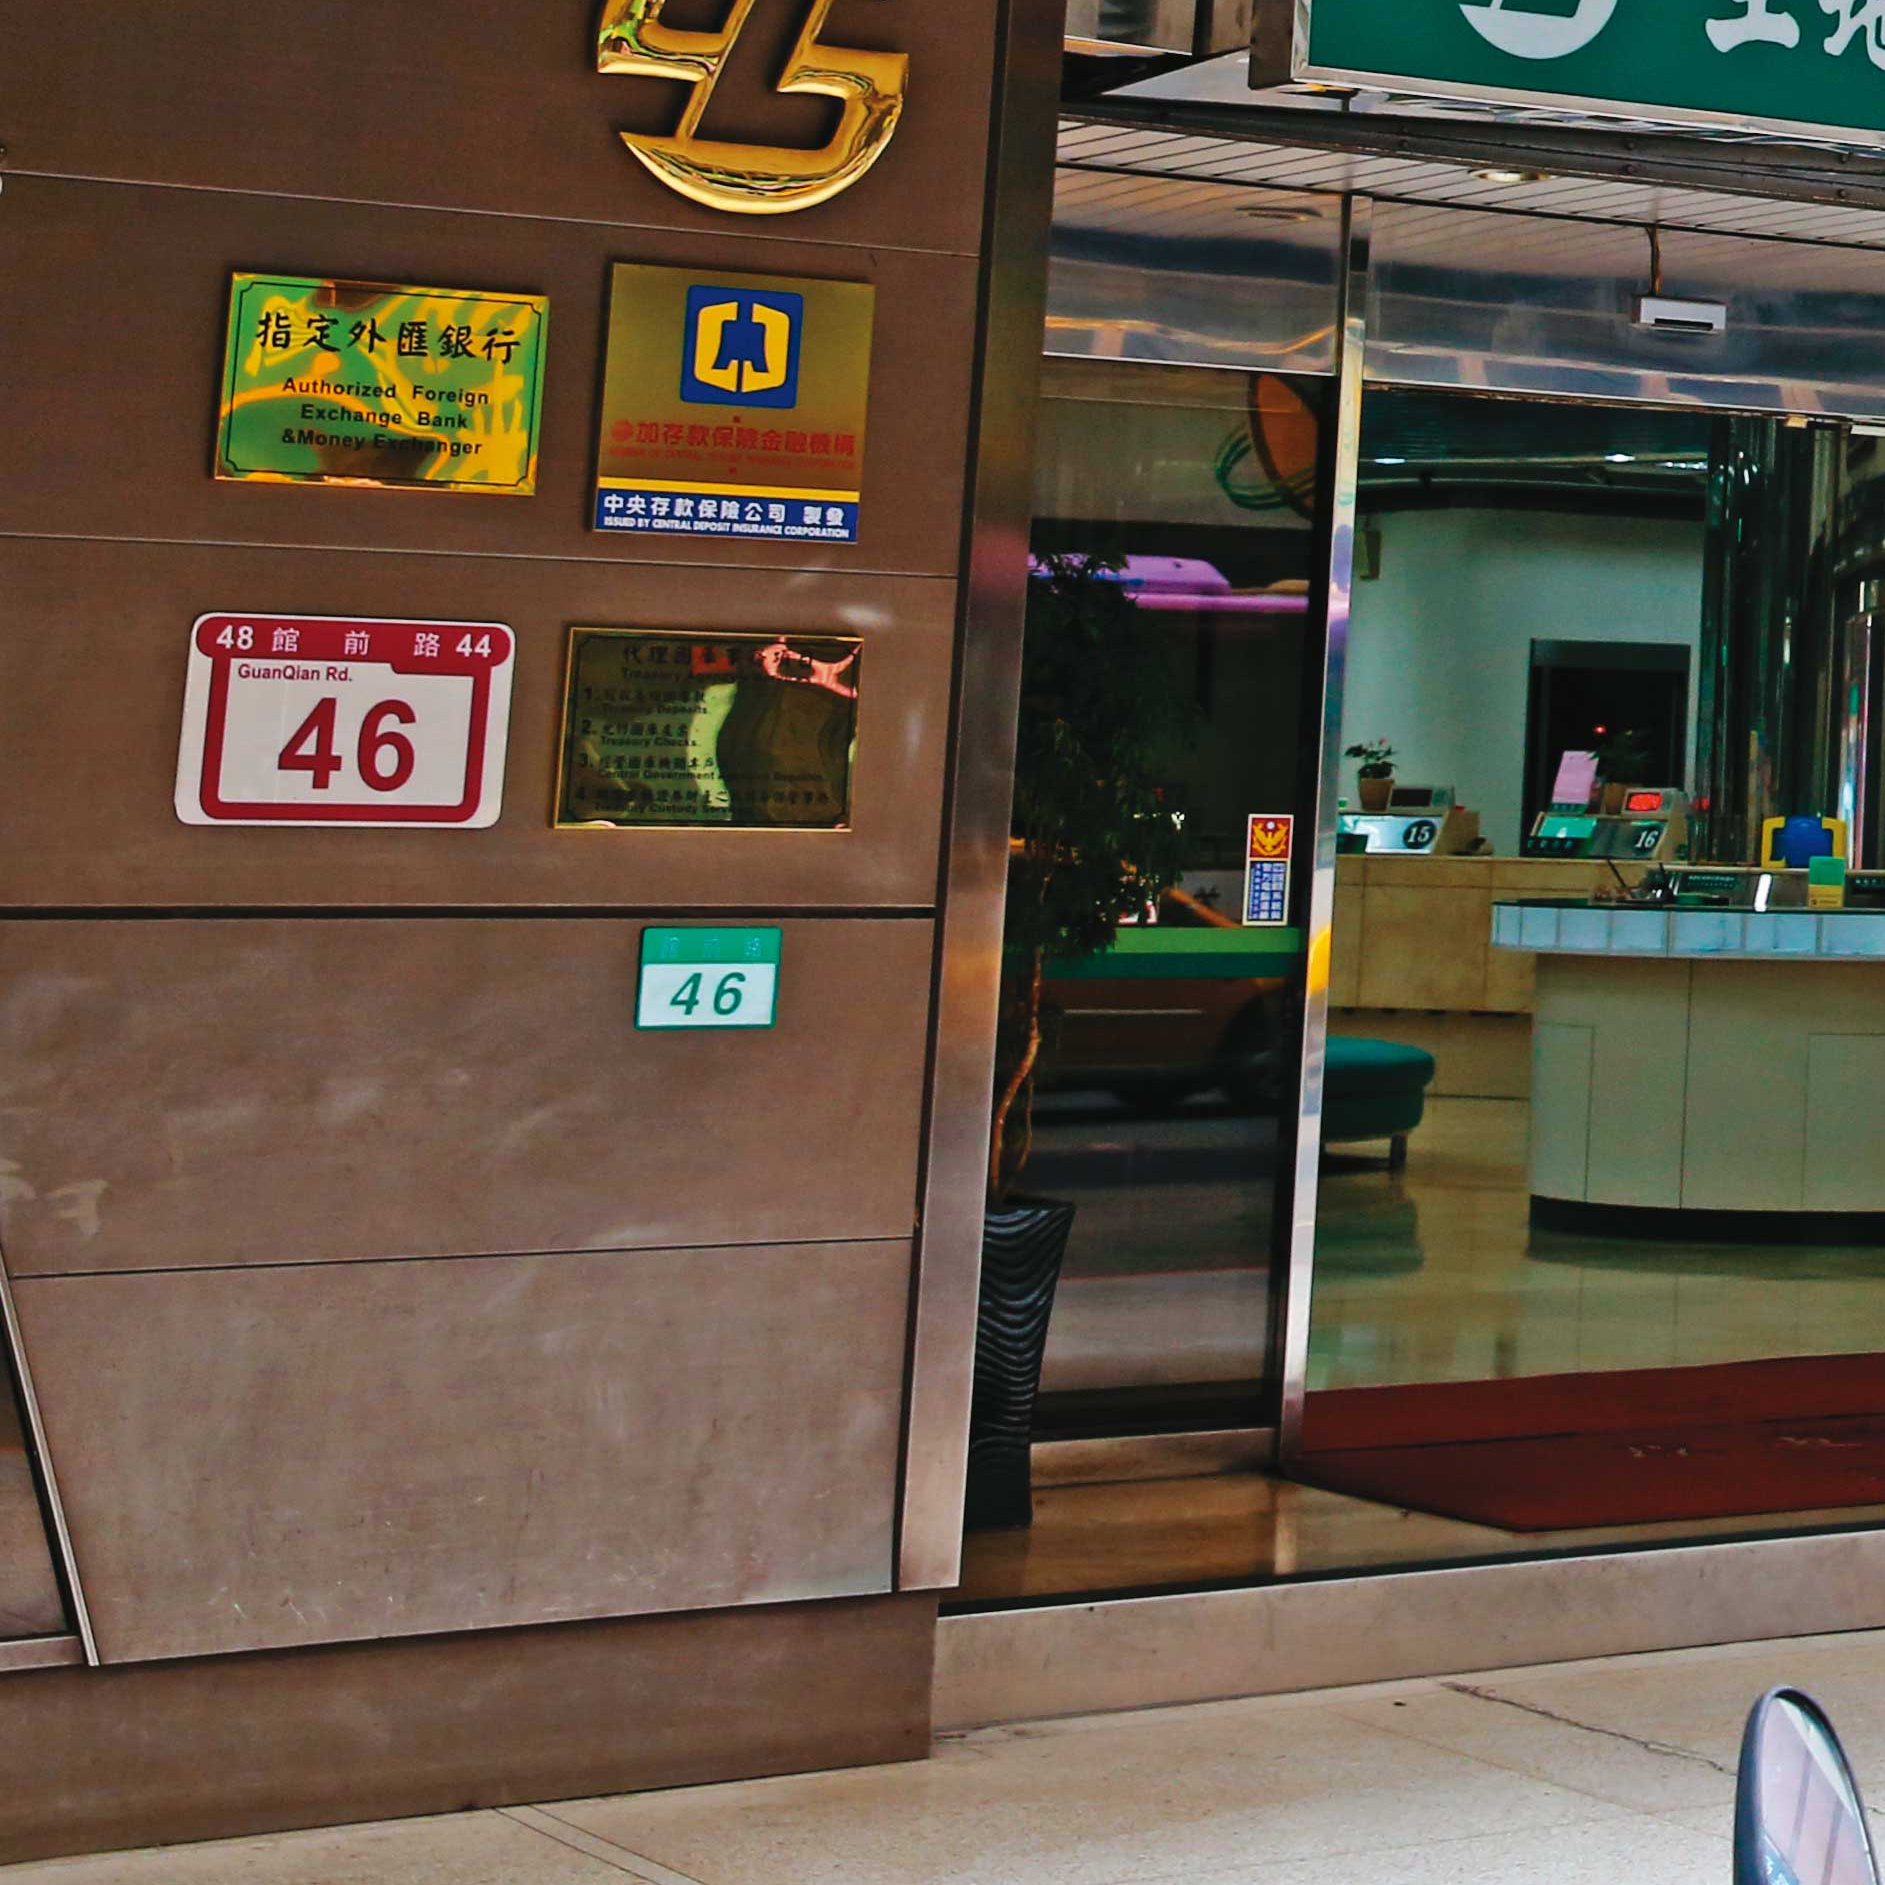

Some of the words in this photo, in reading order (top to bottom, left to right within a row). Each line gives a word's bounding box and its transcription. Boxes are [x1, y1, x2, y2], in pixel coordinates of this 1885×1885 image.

[256, 312, 521, 364] 指定外匯銀行
[283, 377, 396, 399] Authorized
[412, 385, 489, 407] Foreign
[301, 403, 402, 428] Exchange
[417, 412, 468, 429] Bank
[282, 428, 365, 451] &Money
[373, 433, 482, 457] Exchanger
[604, 494, 786, 523] 中央存款保險公司
[604, 516, 636, 528] ISSUED
[637, 517, 651, 528] BY
[652, 518, 691, 531] CENTRAL
[692, 520, 730, 532] DEPOSIT
[731, 523, 782, 535] INSURANCE
[784, 525, 850, 539] CORPORATION
[216, 625, 254, 650] 48
[271, 627, 441, 658] 館前路
[455, 633, 492, 658] 44
[237, 664, 320, 682] GuanQian
[325, 666, 353, 682] Rd.
[277, 697, 417, 793] 46
[1406, 826, 1431, 844] 15
[1635, 830, 1659, 848] 16
[669, 972, 746, 1016] 46
